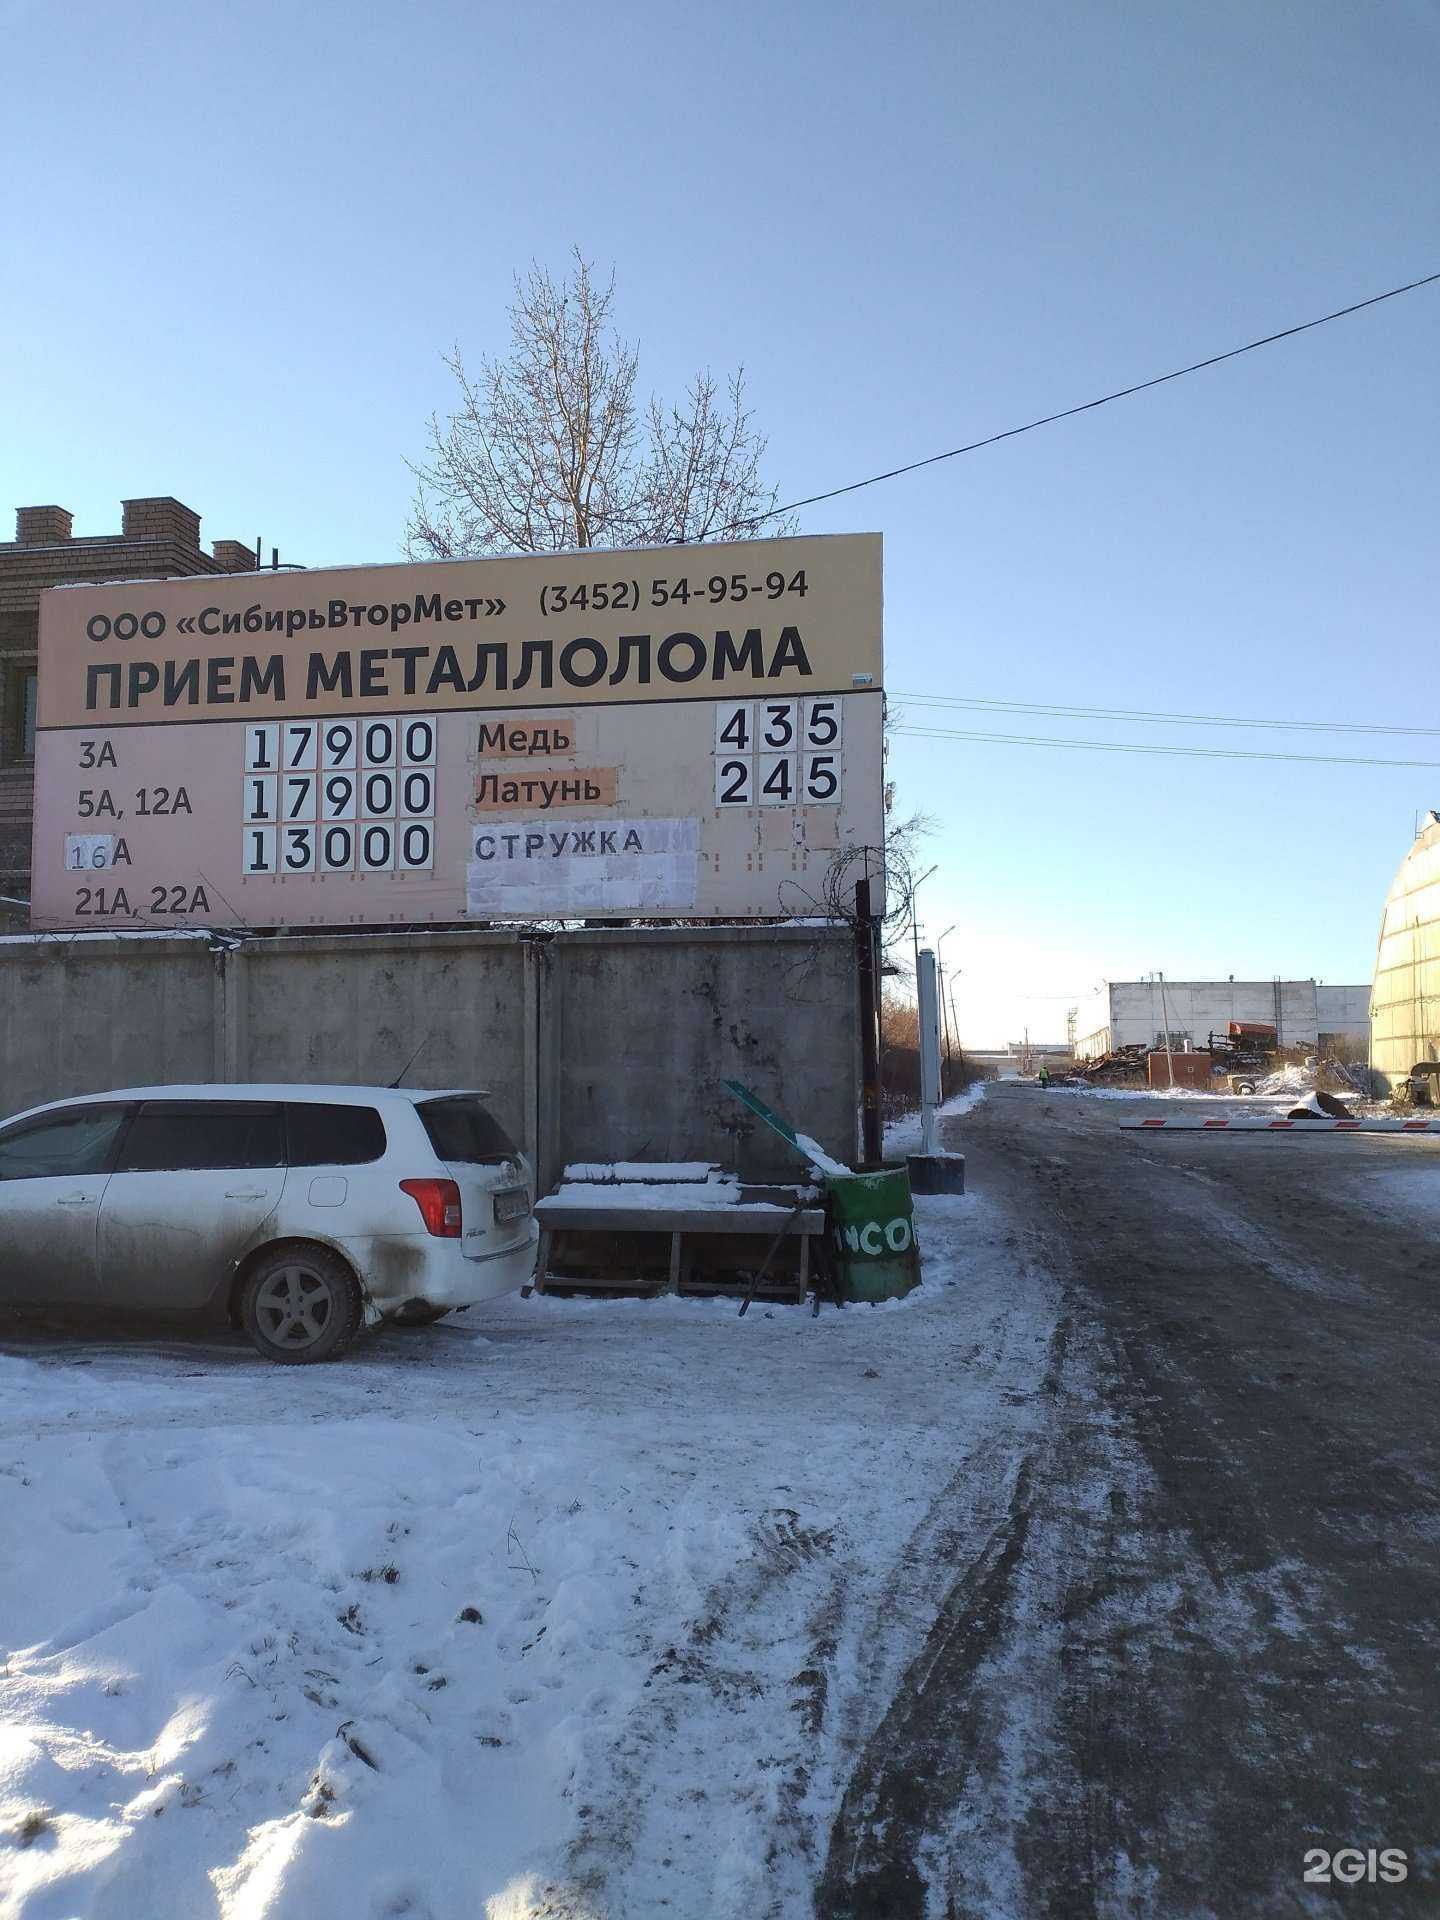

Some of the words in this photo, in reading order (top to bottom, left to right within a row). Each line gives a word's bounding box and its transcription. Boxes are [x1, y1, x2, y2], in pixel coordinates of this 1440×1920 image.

[539, 579, 640, 617] (3452)
[650, 569, 810, 608] 54-95-94
[86, 610, 166, 642] ООО
[177, 593, 506, 637] «СибирьВторМет»
[85, 654, 286, 710] ПРИЕМ
[306, 626, 812, 700] МЕТАЛЛОЛОМА
[78, 740, 118, 769] 3А
[477, 723, 570, 757] Медь
[77, 790, 125, 820] 5А,
[134, 786, 193, 816] 12А
[474, 774, 601, 810] Латунь
[475, 829, 643, 861] СТРУЖКА
[74, 887, 138, 917] 21А,
[150, 885, 210, 915] 22А
